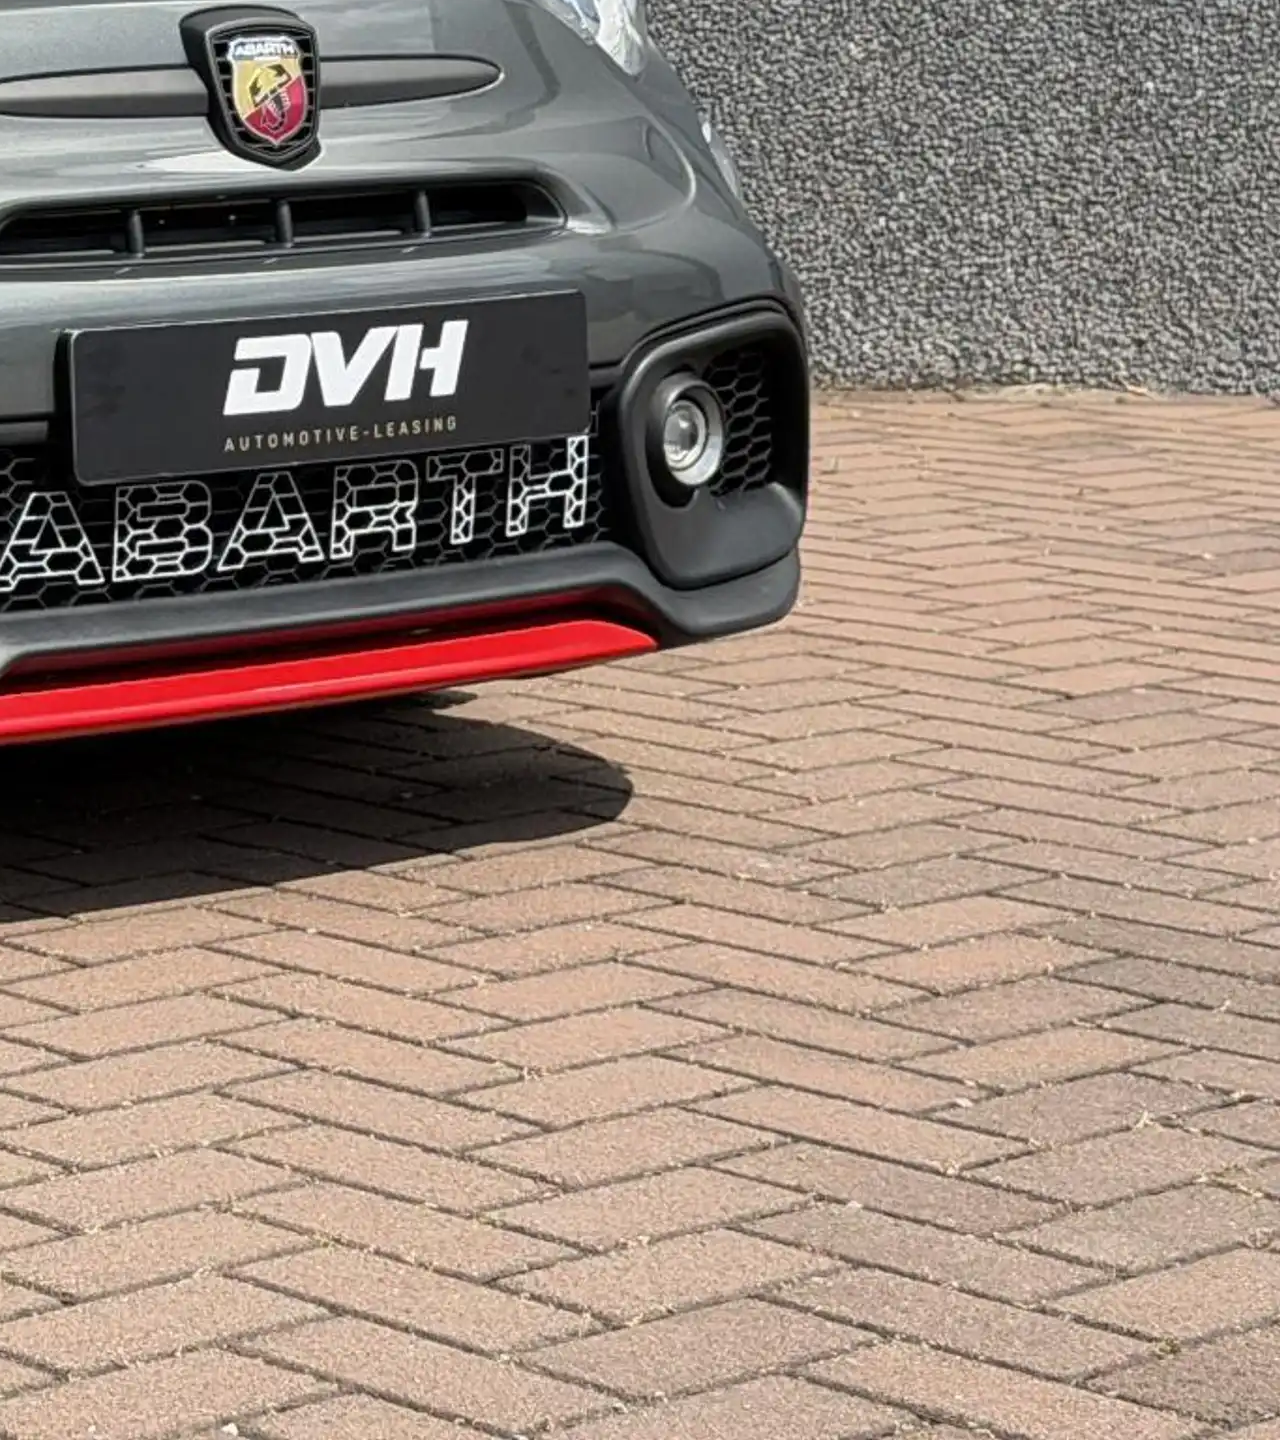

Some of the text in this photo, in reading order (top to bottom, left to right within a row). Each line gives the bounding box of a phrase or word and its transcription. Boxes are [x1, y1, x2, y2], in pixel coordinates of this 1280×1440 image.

[235, 42, 295, 56] ABARTH
[223, 320, 468, 416] DVH
[224, 415, 457, 452] AUTOMOTIVE-LEASING
